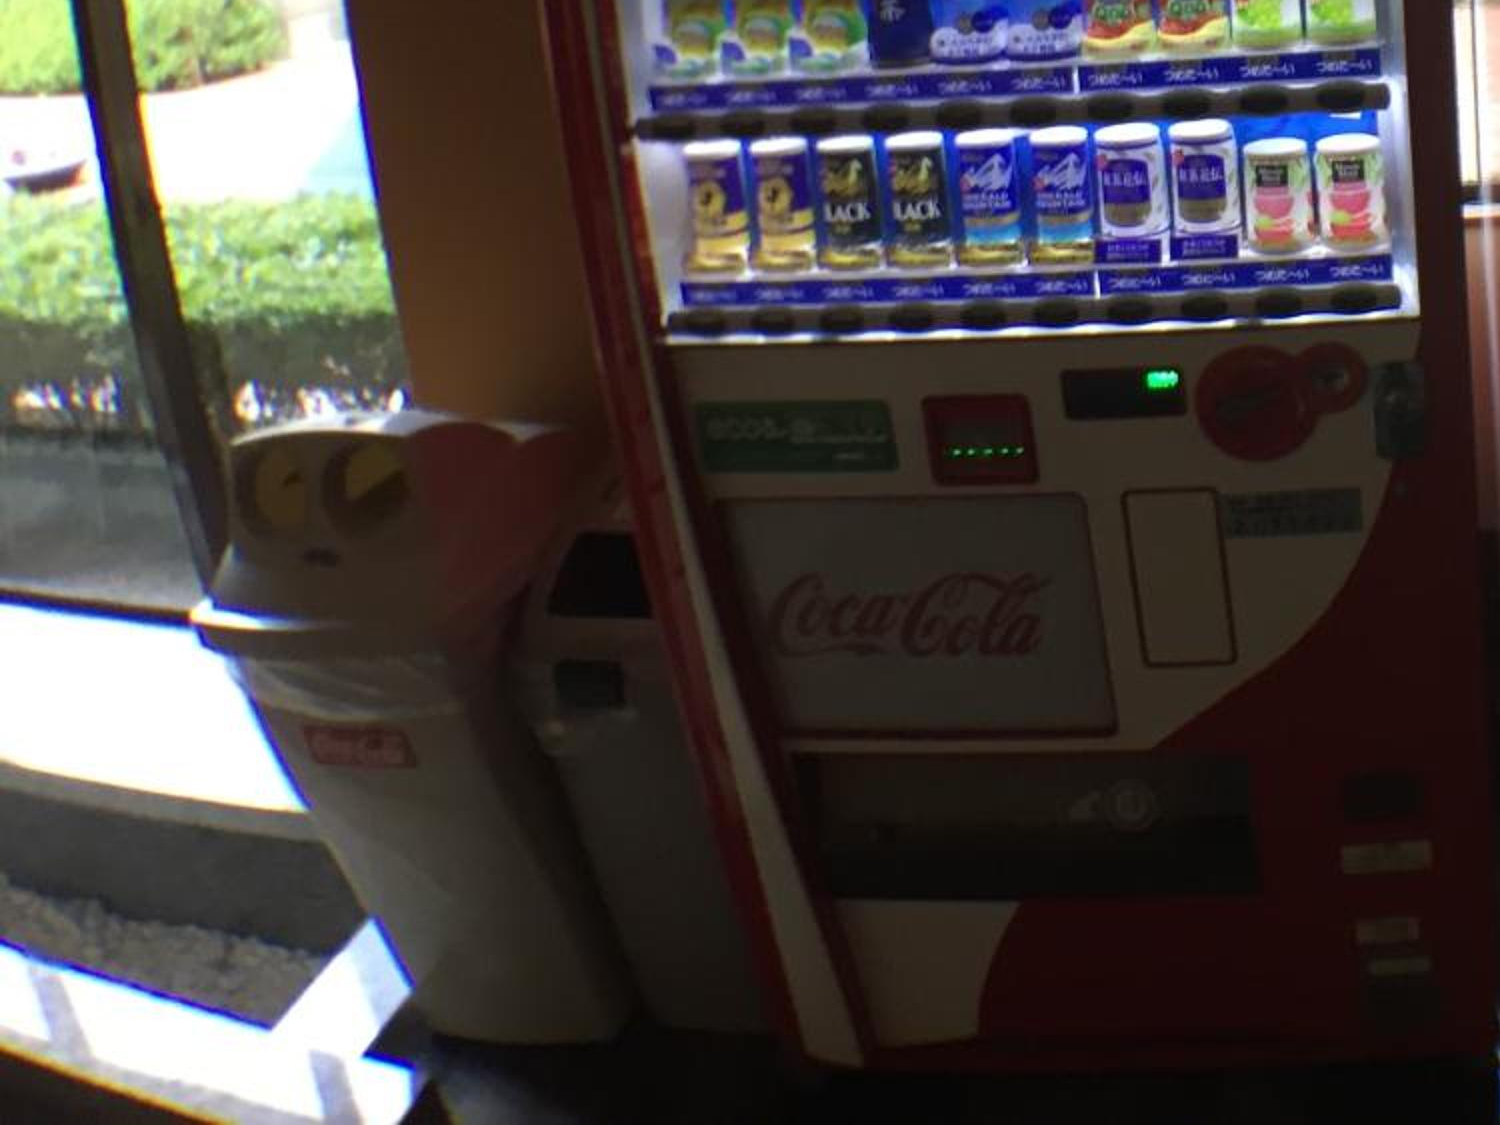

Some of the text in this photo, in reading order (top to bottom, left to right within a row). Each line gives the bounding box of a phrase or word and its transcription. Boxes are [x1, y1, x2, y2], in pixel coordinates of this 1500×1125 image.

[824, 202, 871, 222] LACK
[893, 198, 941, 220] LACK
[769, 572, 1052, 658] Coca-Cola
